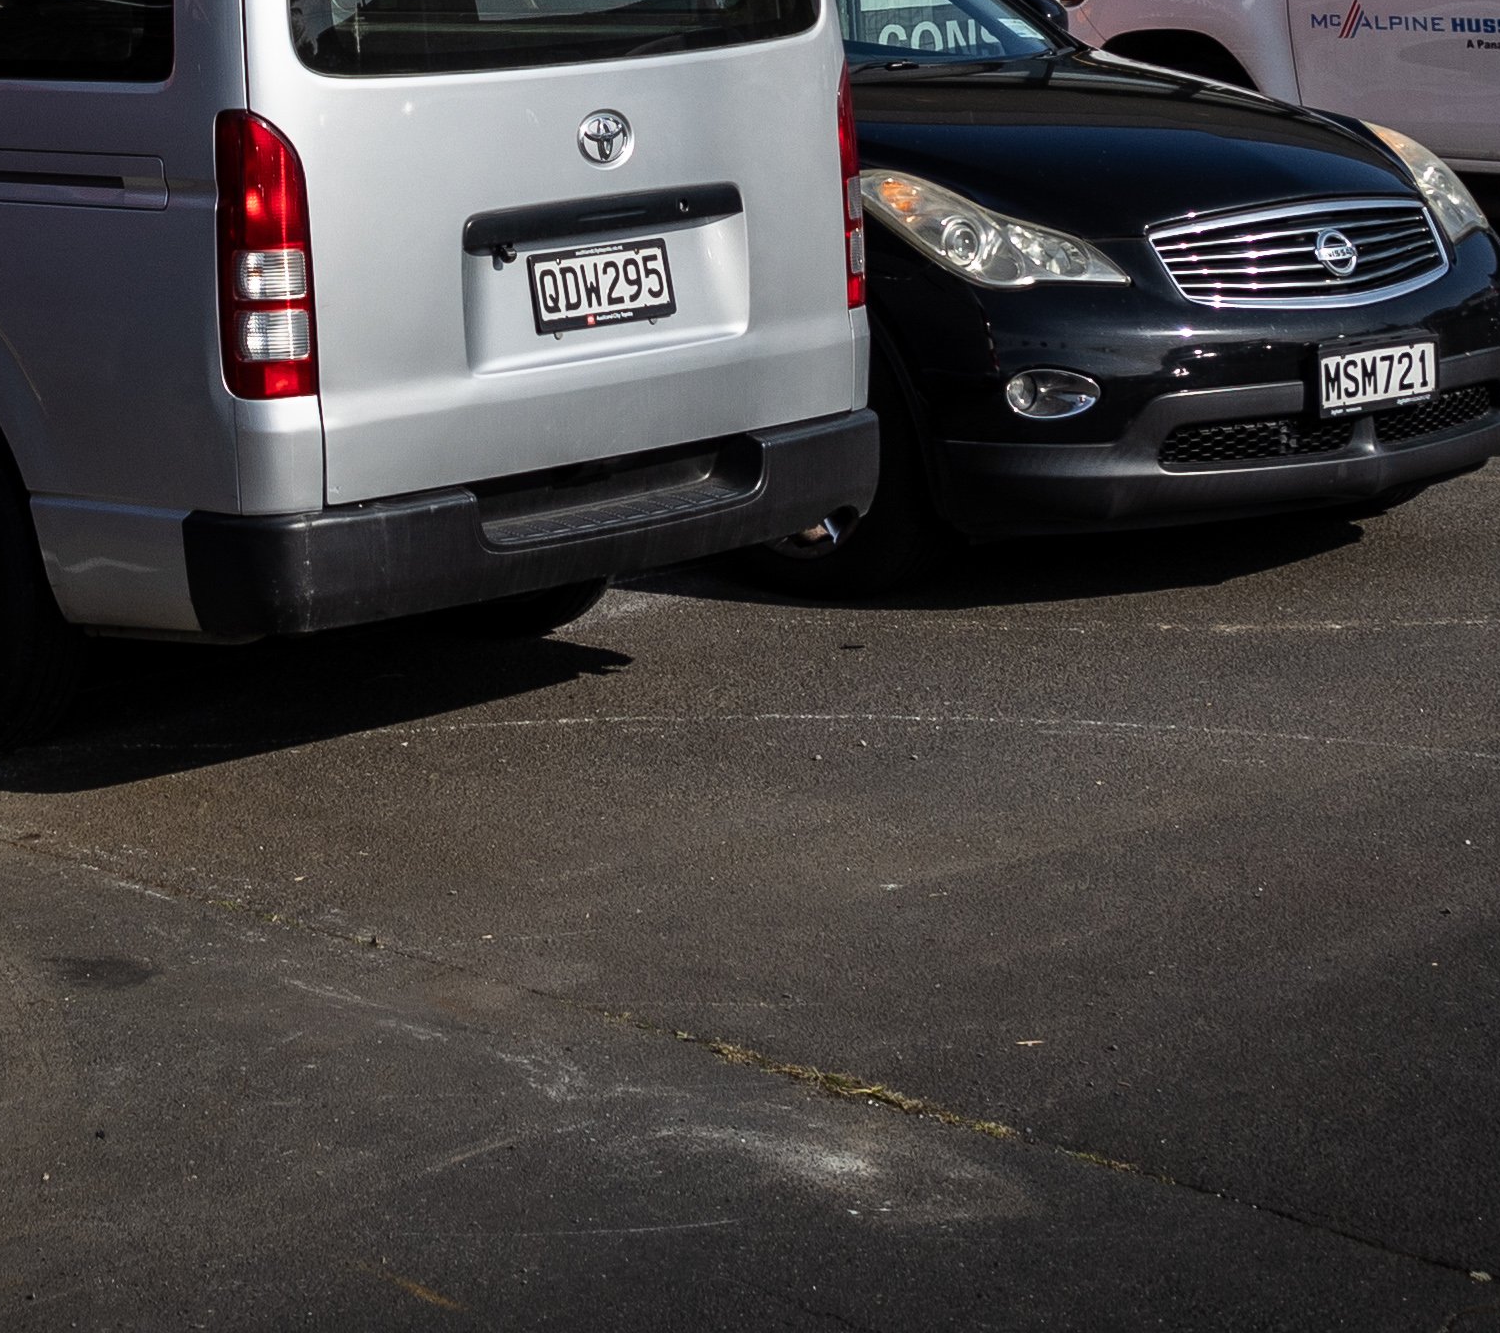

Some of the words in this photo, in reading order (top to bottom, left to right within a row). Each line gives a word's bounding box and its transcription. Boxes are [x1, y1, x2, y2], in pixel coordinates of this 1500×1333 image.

[1467, 39, 1475, 50] A
[538, 253, 665, 314] QDW295
[1324, 349, 1429, 403] MSM721
